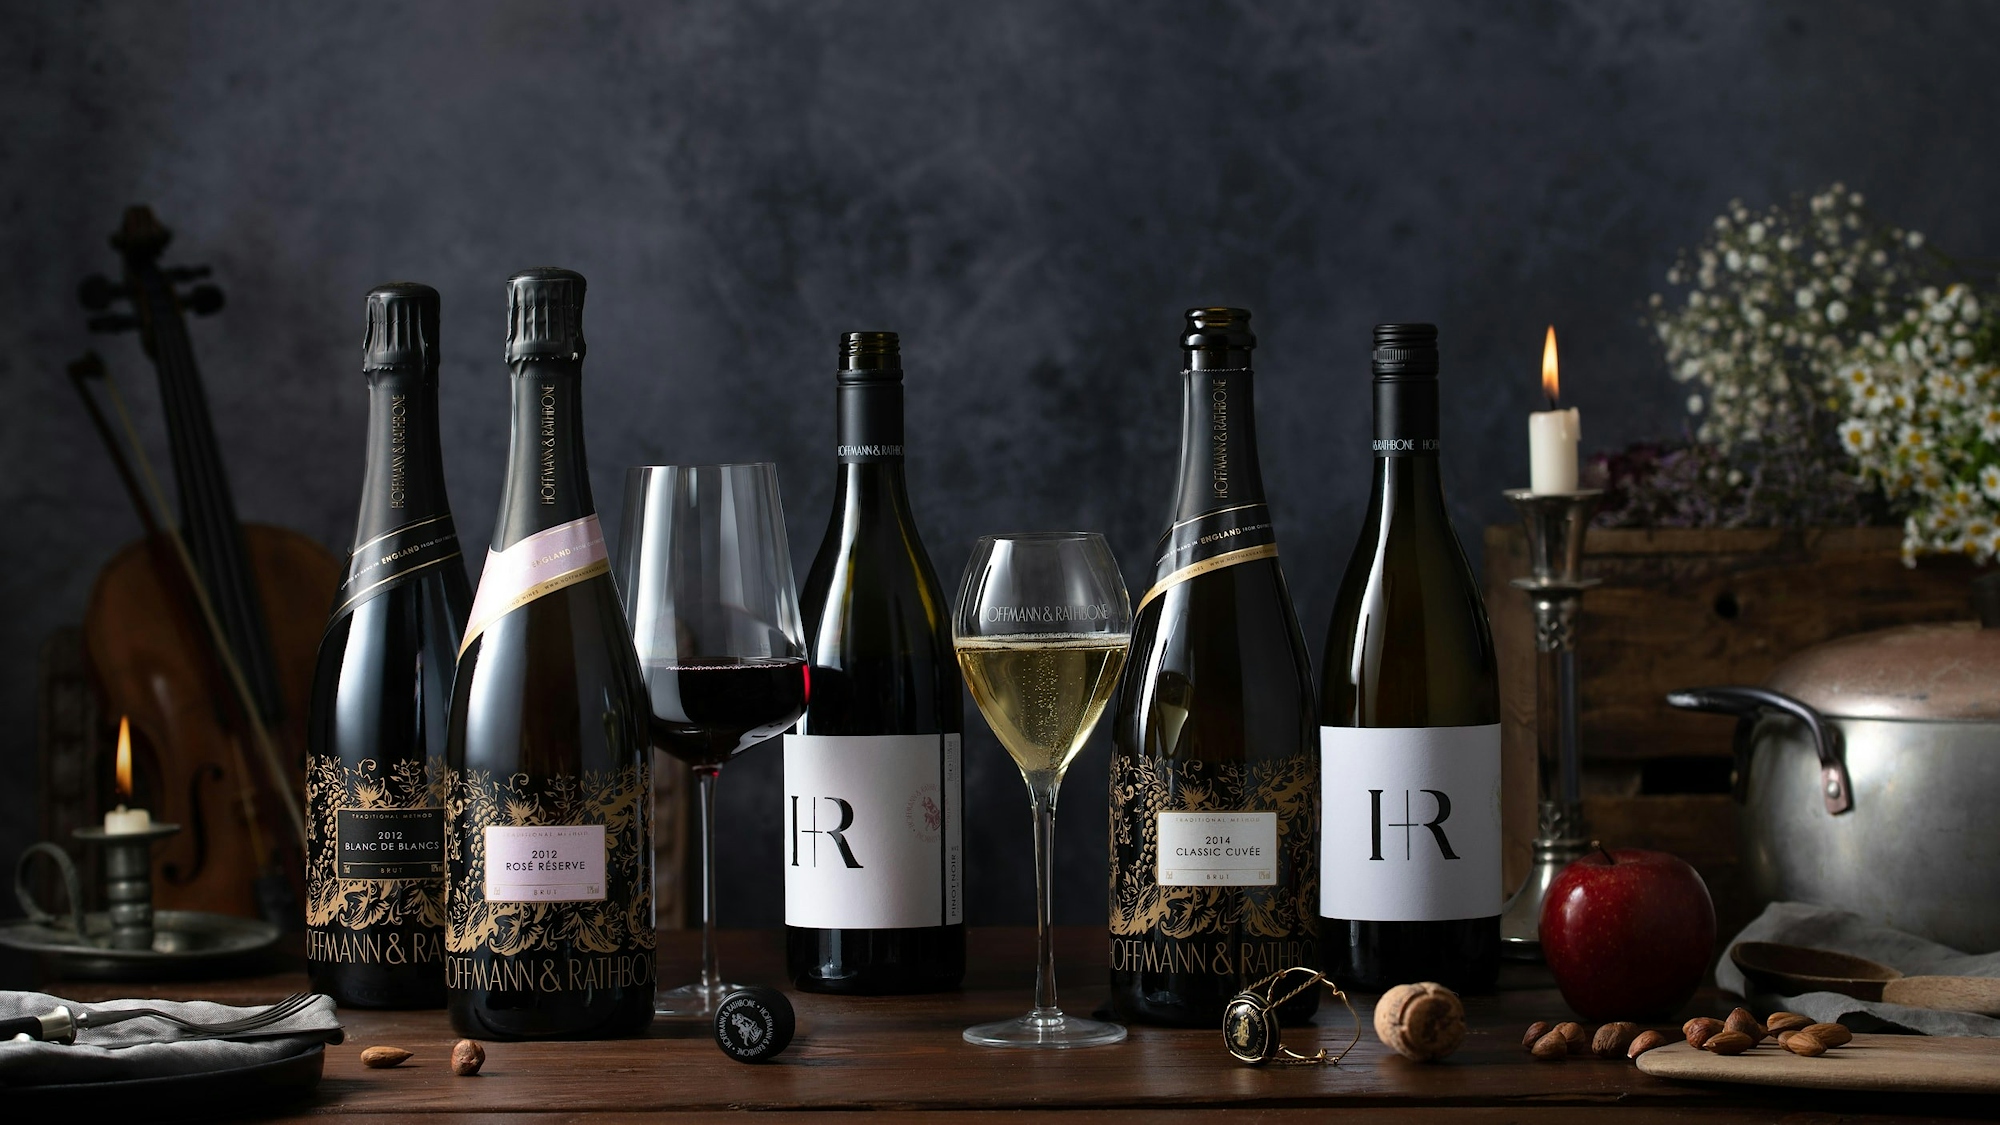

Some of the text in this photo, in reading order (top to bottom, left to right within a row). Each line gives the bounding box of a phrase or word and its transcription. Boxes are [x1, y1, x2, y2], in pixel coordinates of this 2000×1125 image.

[541, 384, 556, 505] HOFFMANN & RATHBONE
[1213, 378, 1228, 499] HOFFMANN & RATHBONE
[1378, 439, 1415, 451] RATHBONE
[391, 394, 405, 509] HOFFMANN & RATHBONE
[873, 445, 881, 456] &
[1200, 527, 1242, 545] ENGLAND
[381, 545, 420, 564] ENGLAND
[531, 548, 571, 568] ENGLAND
[982, 603, 1109, 623] OFFMANN & RATHBONE
[378, 831, 403, 840] 2012
[1205, 836, 1231, 845] 2014
[344, 841, 440, 851] BLANC DE BLANCS
[532, 850, 558, 859] 2012
[1175, 846, 1261, 856] CLASSIC CUVÉE
[506, 860, 586, 871] ROSÉ RÉSERVE
[306, 928, 381, 964] OFFMANN
[385, 932, 408, 964] &
[1212, 941, 1234, 975] &
[1241, 938, 1316, 974] RATHBO
[539, 959, 563, 992] &
[569, 953, 656, 990] RATHBON
[726, 999, 755, 1012] RATHBONE
